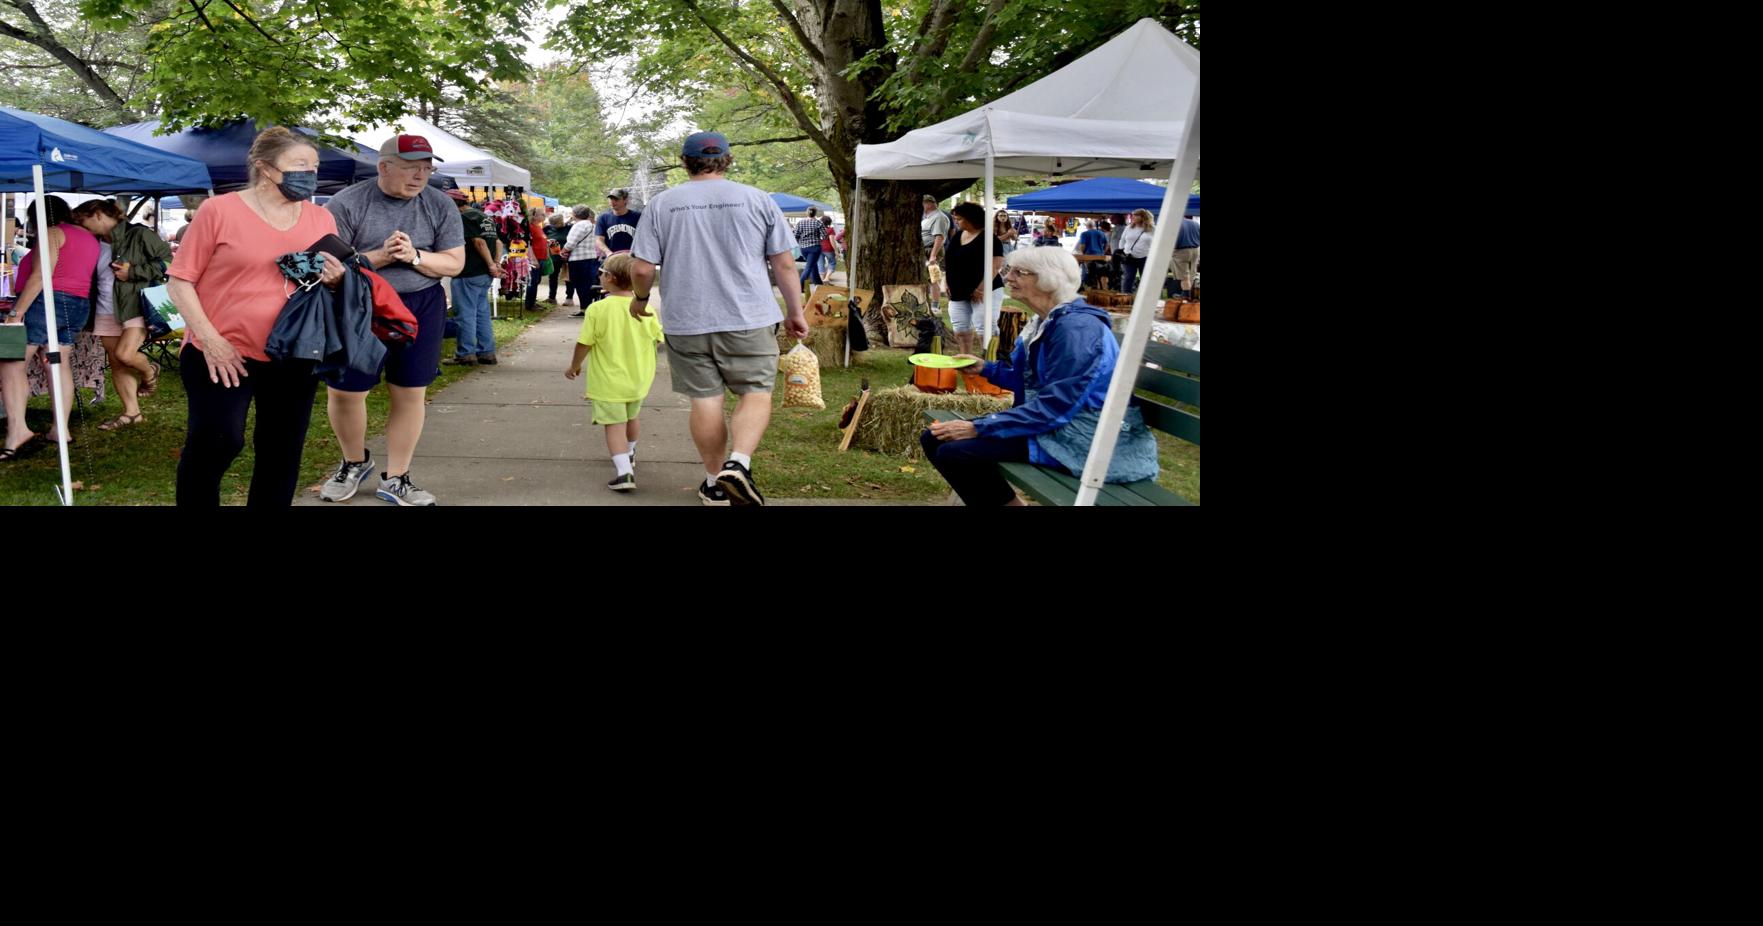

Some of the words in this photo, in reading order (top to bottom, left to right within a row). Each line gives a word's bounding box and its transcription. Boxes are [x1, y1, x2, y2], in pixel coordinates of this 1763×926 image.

[669, 205, 690, 214] Who's
[691, 203, 707, 211] Your
[709, 202, 745, 211] Engineer?
